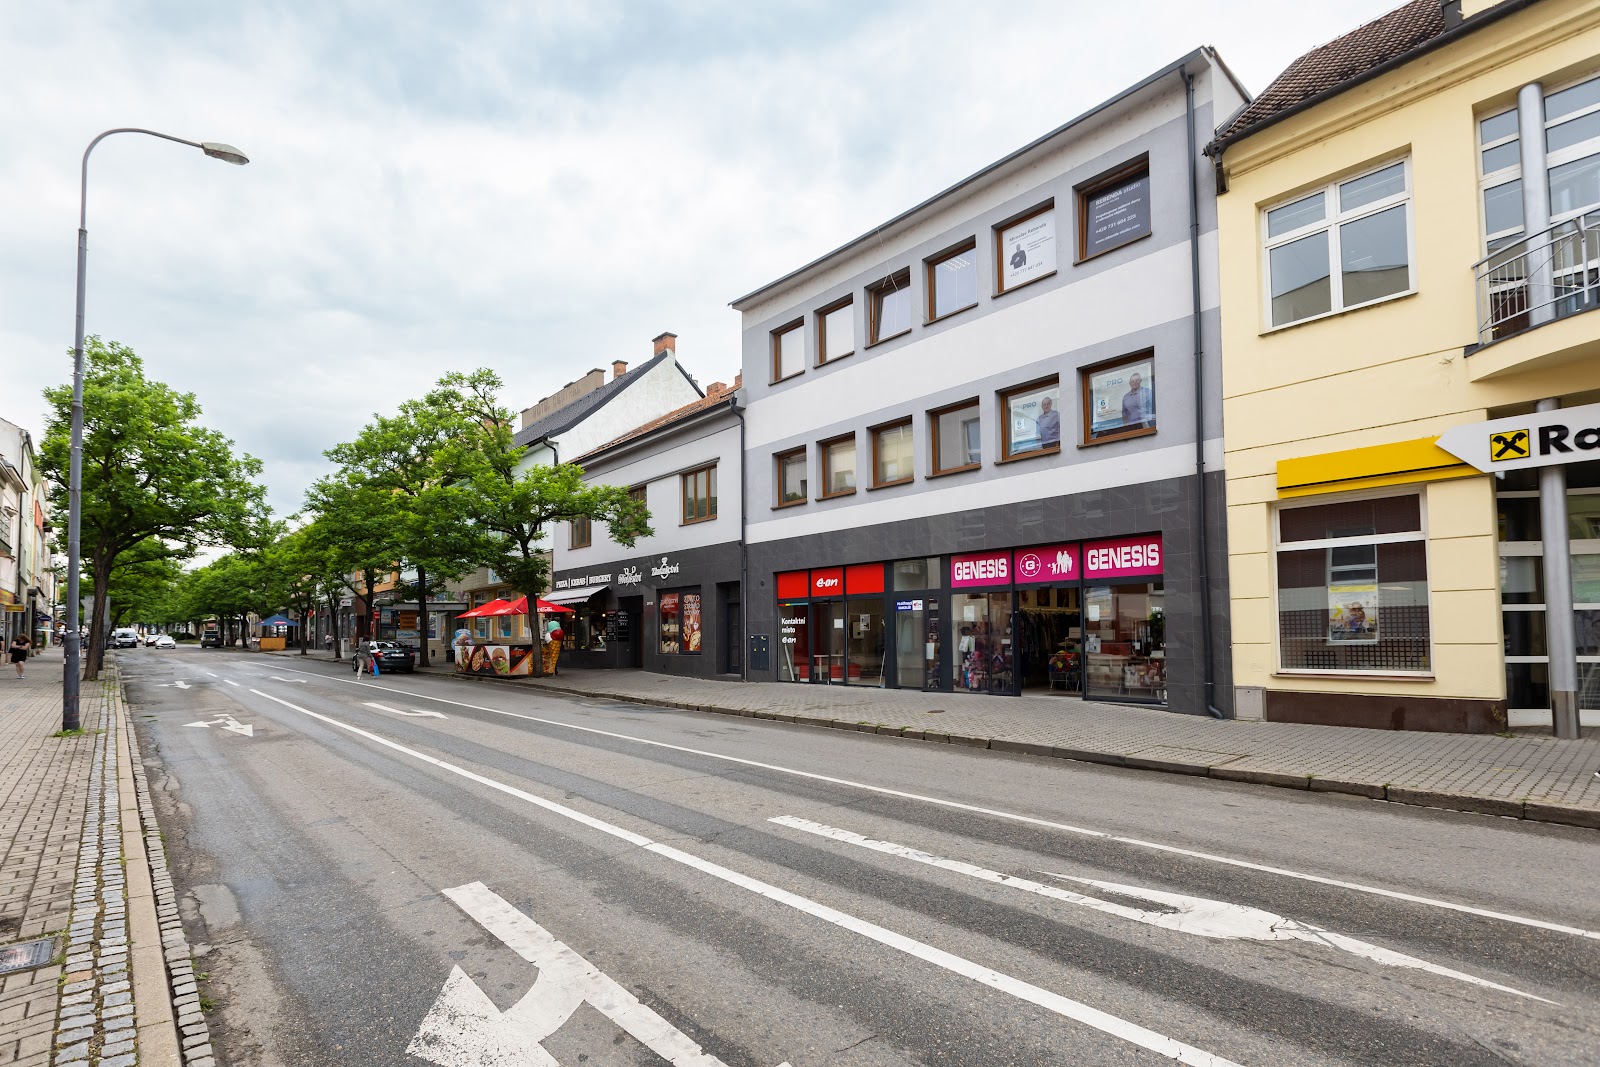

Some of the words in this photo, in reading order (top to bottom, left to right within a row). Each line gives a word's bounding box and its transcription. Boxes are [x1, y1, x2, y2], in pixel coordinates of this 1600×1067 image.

[1095, 190, 1122, 206] REBENDA
[1123, 182, 1141, 194] studio
[1095, 226, 1107, 234] +420
[1009, 231, 1027, 242] Miroslav
[1106, 378, 1124, 387] PRO
[1022, 401, 1037, 410] PRO
[1538, 424, 1600, 456] Ra
[1087, 544, 1160, 571] GENESIS
[954, 558, 1008, 581] GENESIS
[556, 580, 568, 588] PIZZA
[570, 578, 586, 587] KEBAB
[589, 574, 612, 585] BURGERY
[781, 616, 806, 625] Kontaktní
[781, 626, 796, 634] místo
